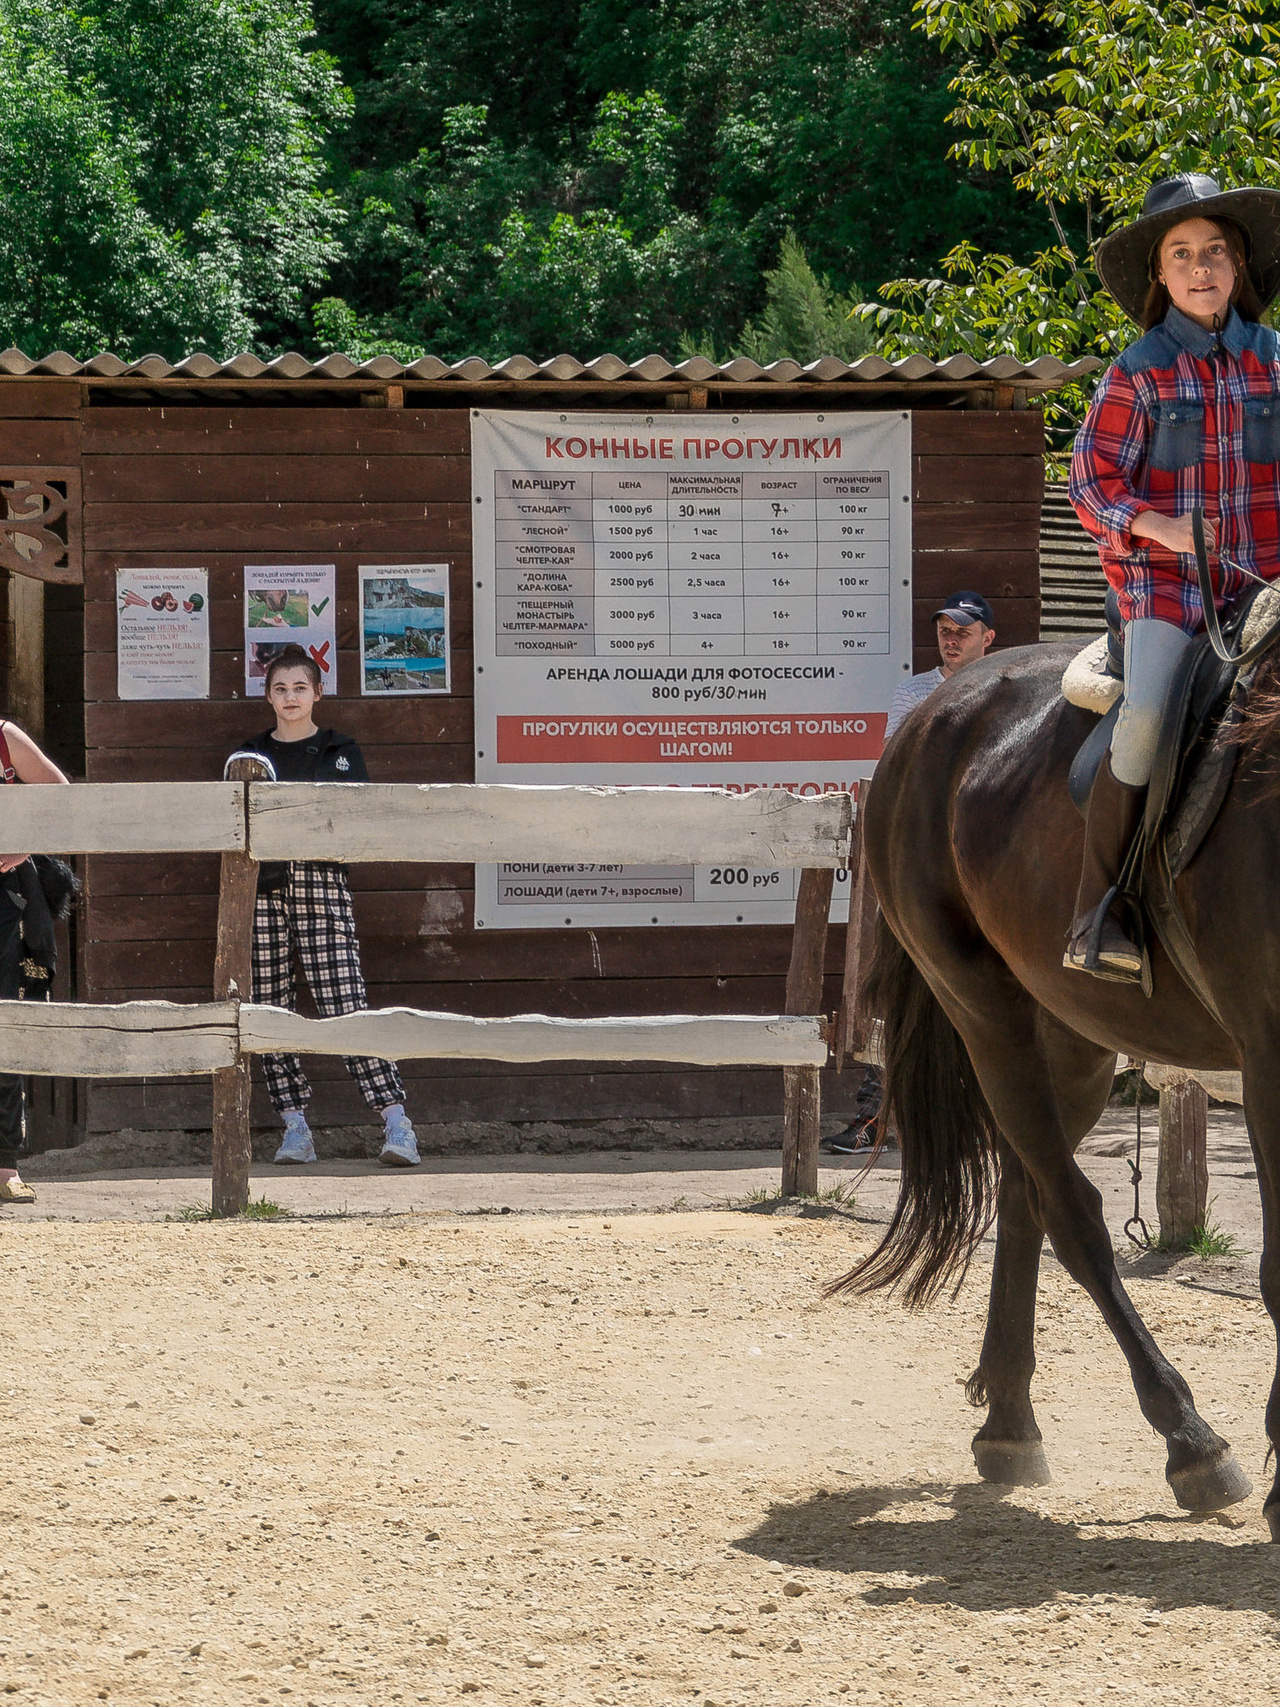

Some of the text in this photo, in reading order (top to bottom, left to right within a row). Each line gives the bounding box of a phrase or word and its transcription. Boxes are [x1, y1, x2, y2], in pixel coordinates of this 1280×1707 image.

[545, 437, 842, 459] КОННЫЕ ПРОГУЛКИ
[669, 476, 741, 484] МАКСИМАЛЬНАЯ
[822, 476, 882, 484] ОГРАНИЧЕНИЯ
[512, 479, 576, 491] МАРШРУТ
[618, 482, 642, 490] ЦЕНА
[671, 486, 739, 494] ДЛИТЕЛЬНОСТЬ
[850, 486, 869, 494] ВЕСУ
[517, 505, 571, 514] "СТАНДАРТ"
[608, 505, 653, 517] 1000 руб
[678, 505, 721, 517] 30 мин
[771, 503, 789, 518] 7+
[839, 505, 868, 514] 100 кг
[521, 526, 568, 535] "ЛЕСНОЙ"
[608, 526, 653, 538] 1500 руб
[693, 528, 698, 536] 1
[771, 527, 789, 536] 16+
[841, 527, 866, 536] 90 кг
[515, 546, 575, 554] "СМОТРОВАЯ
[609, 551, 654, 562] 2000 руб
[691, 552, 697, 560] 2
[771, 551, 790, 560] 16+
[841, 551, 853, 559] 90
[516, 556, 574, 565] ЧЕЛТЕР-КАЯ"
[523, 573, 567, 582] "ДОЛИНА
[838, 578, 869, 586] 100 кг
[610, 578, 654, 589] 2500 руб
[687, 579, 726, 588] 2,5 часа
[772, 578, 791, 587] 16+
[517, 583, 573, 592] КАРА-КОБА"
[517, 600, 574, 610] "ПЕЩЕРНЫЙ
[516, 611, 575, 620] МОНАСТЫРЬ
[609, 610, 655, 621] 3000 руб
[692, 611, 722, 620] 3 часа
[772, 611, 790, 619] 16+
[841, 610, 867, 619] 90 кг
[503, 622, 588, 630] ЧЕЛТЕР-МАРМАРА"
[514, 640, 578, 651] "ПОХОДНЫЙ"
[609, 640, 655, 651] 5000 руб
[701, 641, 714, 650] 4+
[772, 640, 790, 648] 18+
[842, 640, 867, 648] 90 кг
[546, 668, 610, 682] АРЕНДА
[613, 668, 688, 682] ЛОШАДИ
[691, 668, 724, 682] ДЛЯ
[728, 666, 835, 680] ФОТОСЕССИИ
[651, 687, 680, 699] 800
[737, 689, 767, 700] мин
[522, 720, 867, 738] ПРОГУЛКИ ОСУЩЕСТВЛЯЮТСЯ ТОЛЬКО
[660, 742, 733, 756] ШАГОМ!
[503, 863, 624, 874] ПОНИ (дети 3-7 лет)
[709, 868, 780, 888] 200 руб
[504, 885, 683, 898] ЛОШАДИ (дети 7+, взрослые)
